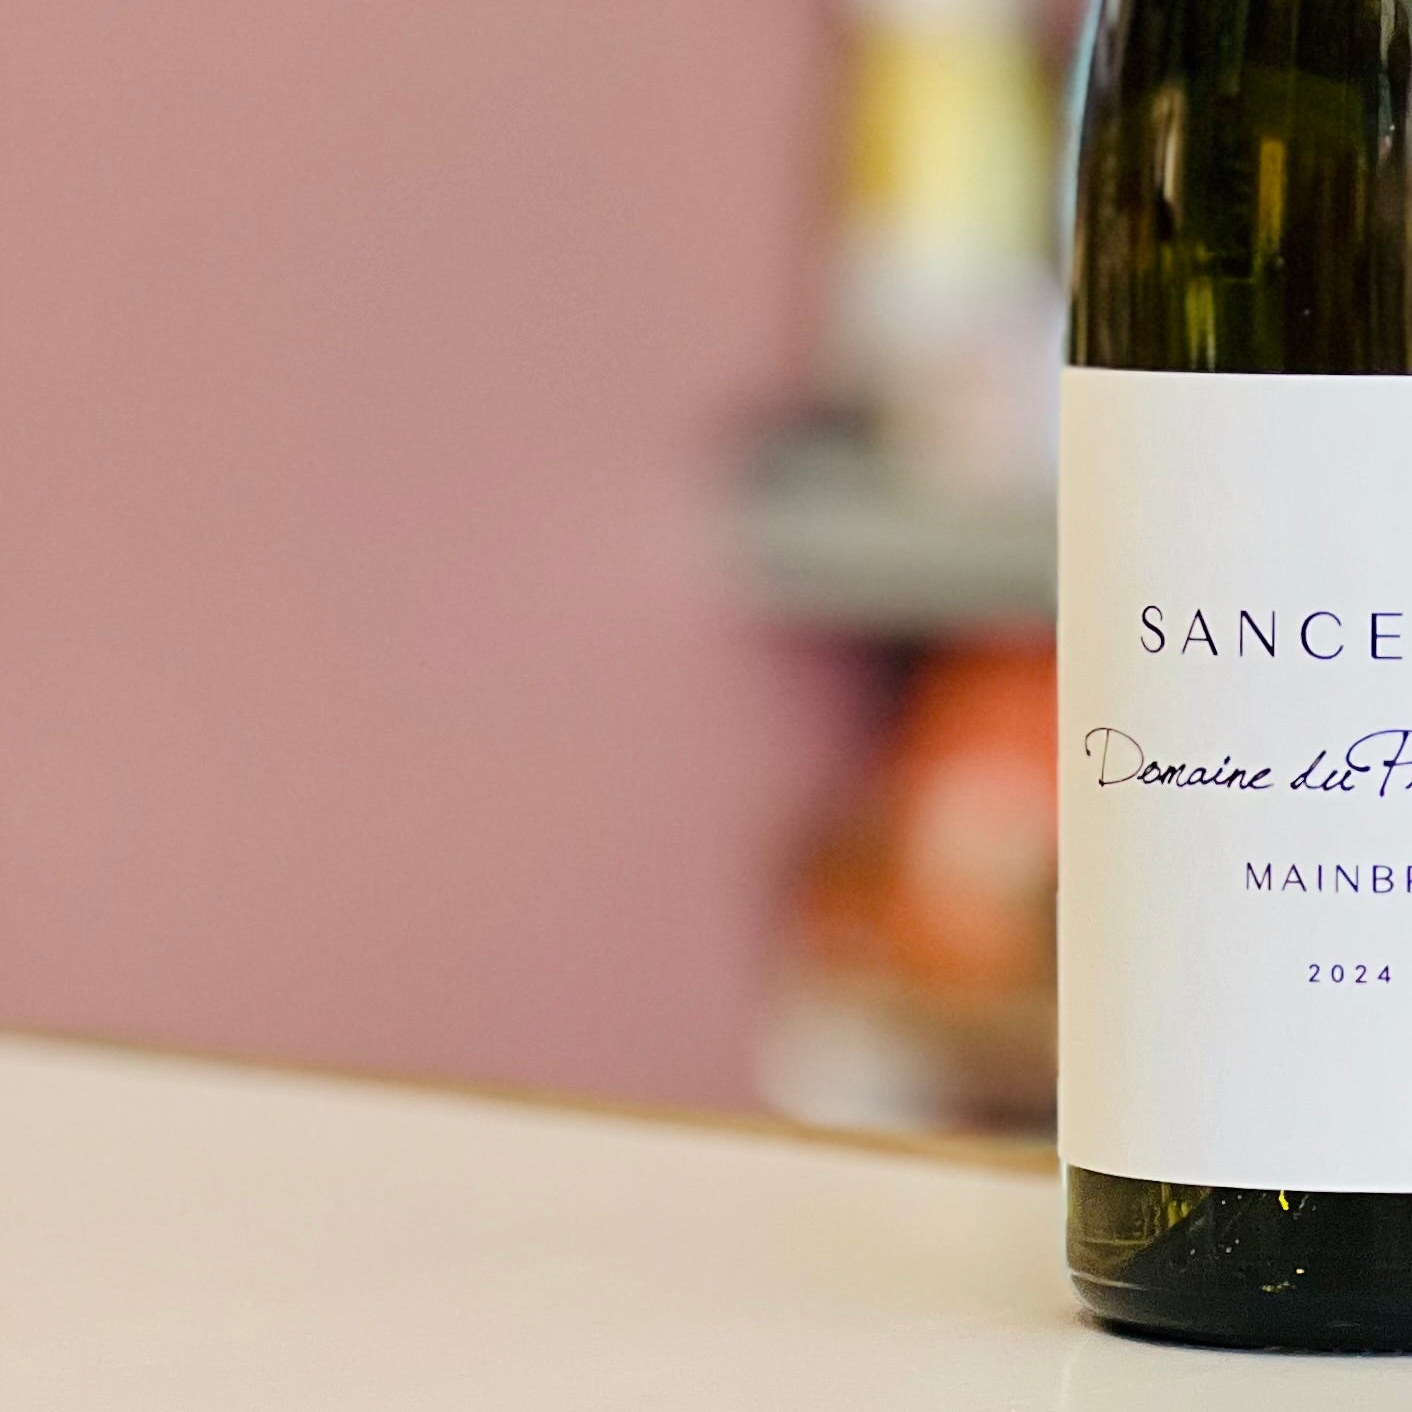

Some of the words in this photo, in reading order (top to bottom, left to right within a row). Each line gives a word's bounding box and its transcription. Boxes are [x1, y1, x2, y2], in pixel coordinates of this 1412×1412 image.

[1083, 726, 1275, 790] Domaine
[1289, 749, 1356, 793] du
[1307, 963, 1392, 984] 2024
